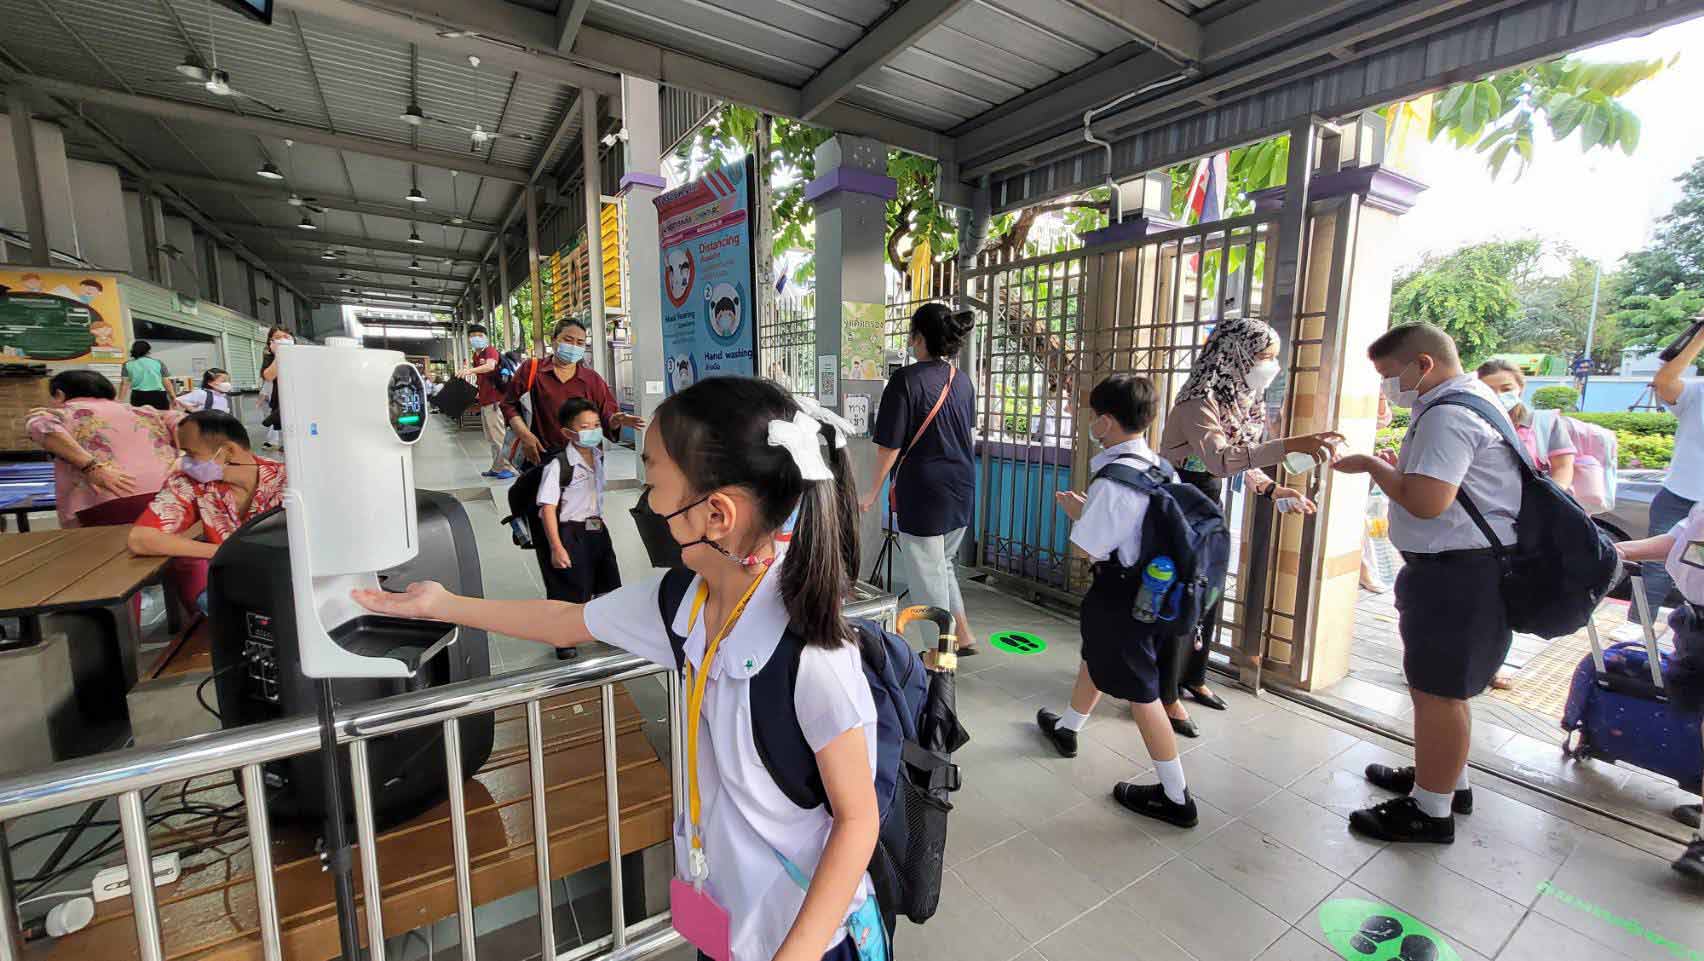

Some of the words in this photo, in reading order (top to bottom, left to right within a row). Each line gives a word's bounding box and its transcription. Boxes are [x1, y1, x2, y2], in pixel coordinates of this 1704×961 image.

[699, 234, 740, 253] Distancing
[704, 351, 723, 360] Hand
[726, 348, 753, 359] washing
[848, 404, 866, 413] ทาง
